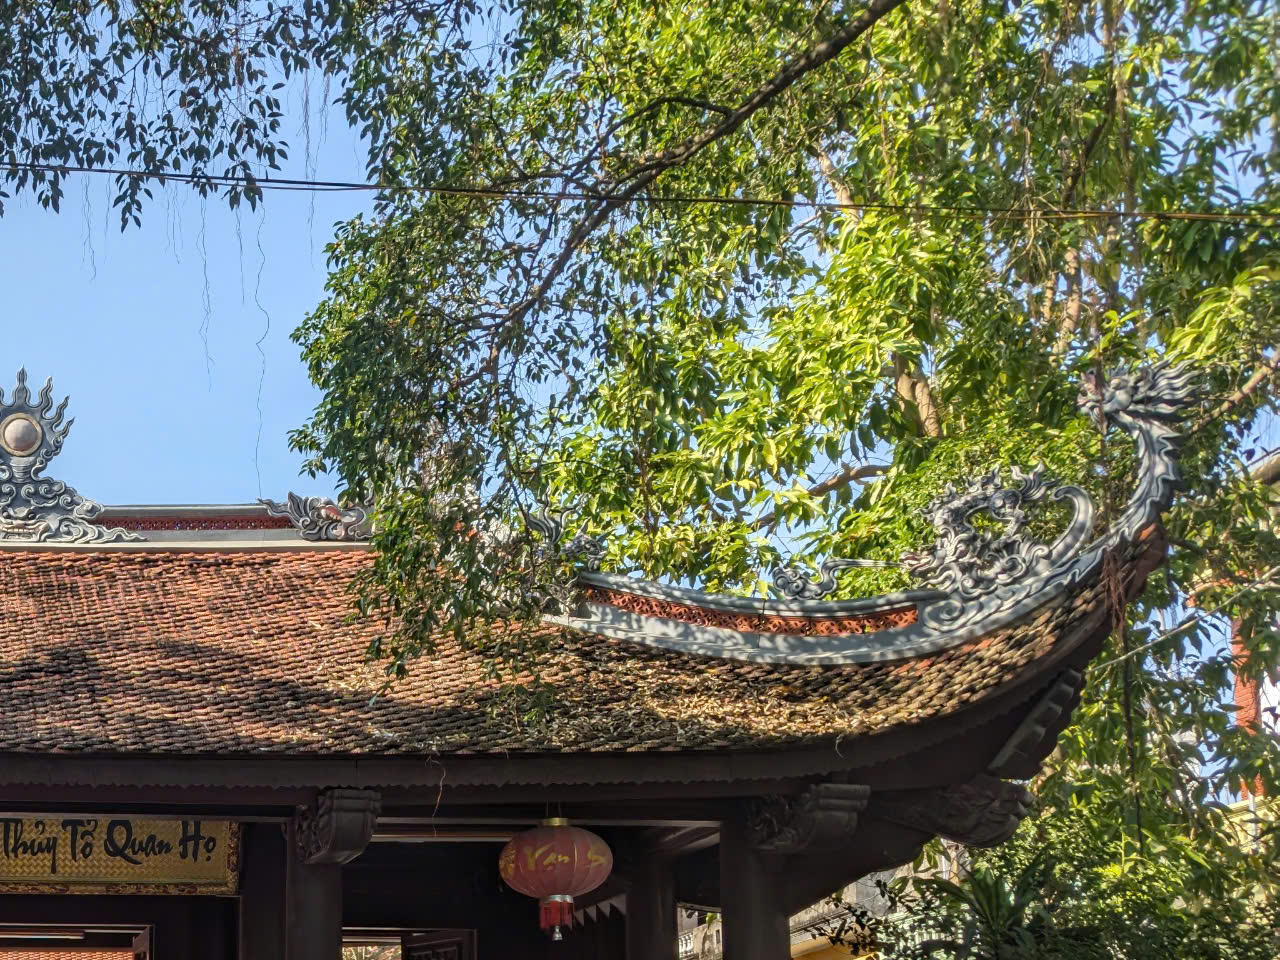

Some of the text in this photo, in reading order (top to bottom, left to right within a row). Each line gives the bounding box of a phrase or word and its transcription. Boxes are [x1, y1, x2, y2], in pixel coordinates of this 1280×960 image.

[61, 818, 99, 863] Tổ
[104, 819, 173, 865] Quan
[178, 820, 217, 863] Họ
